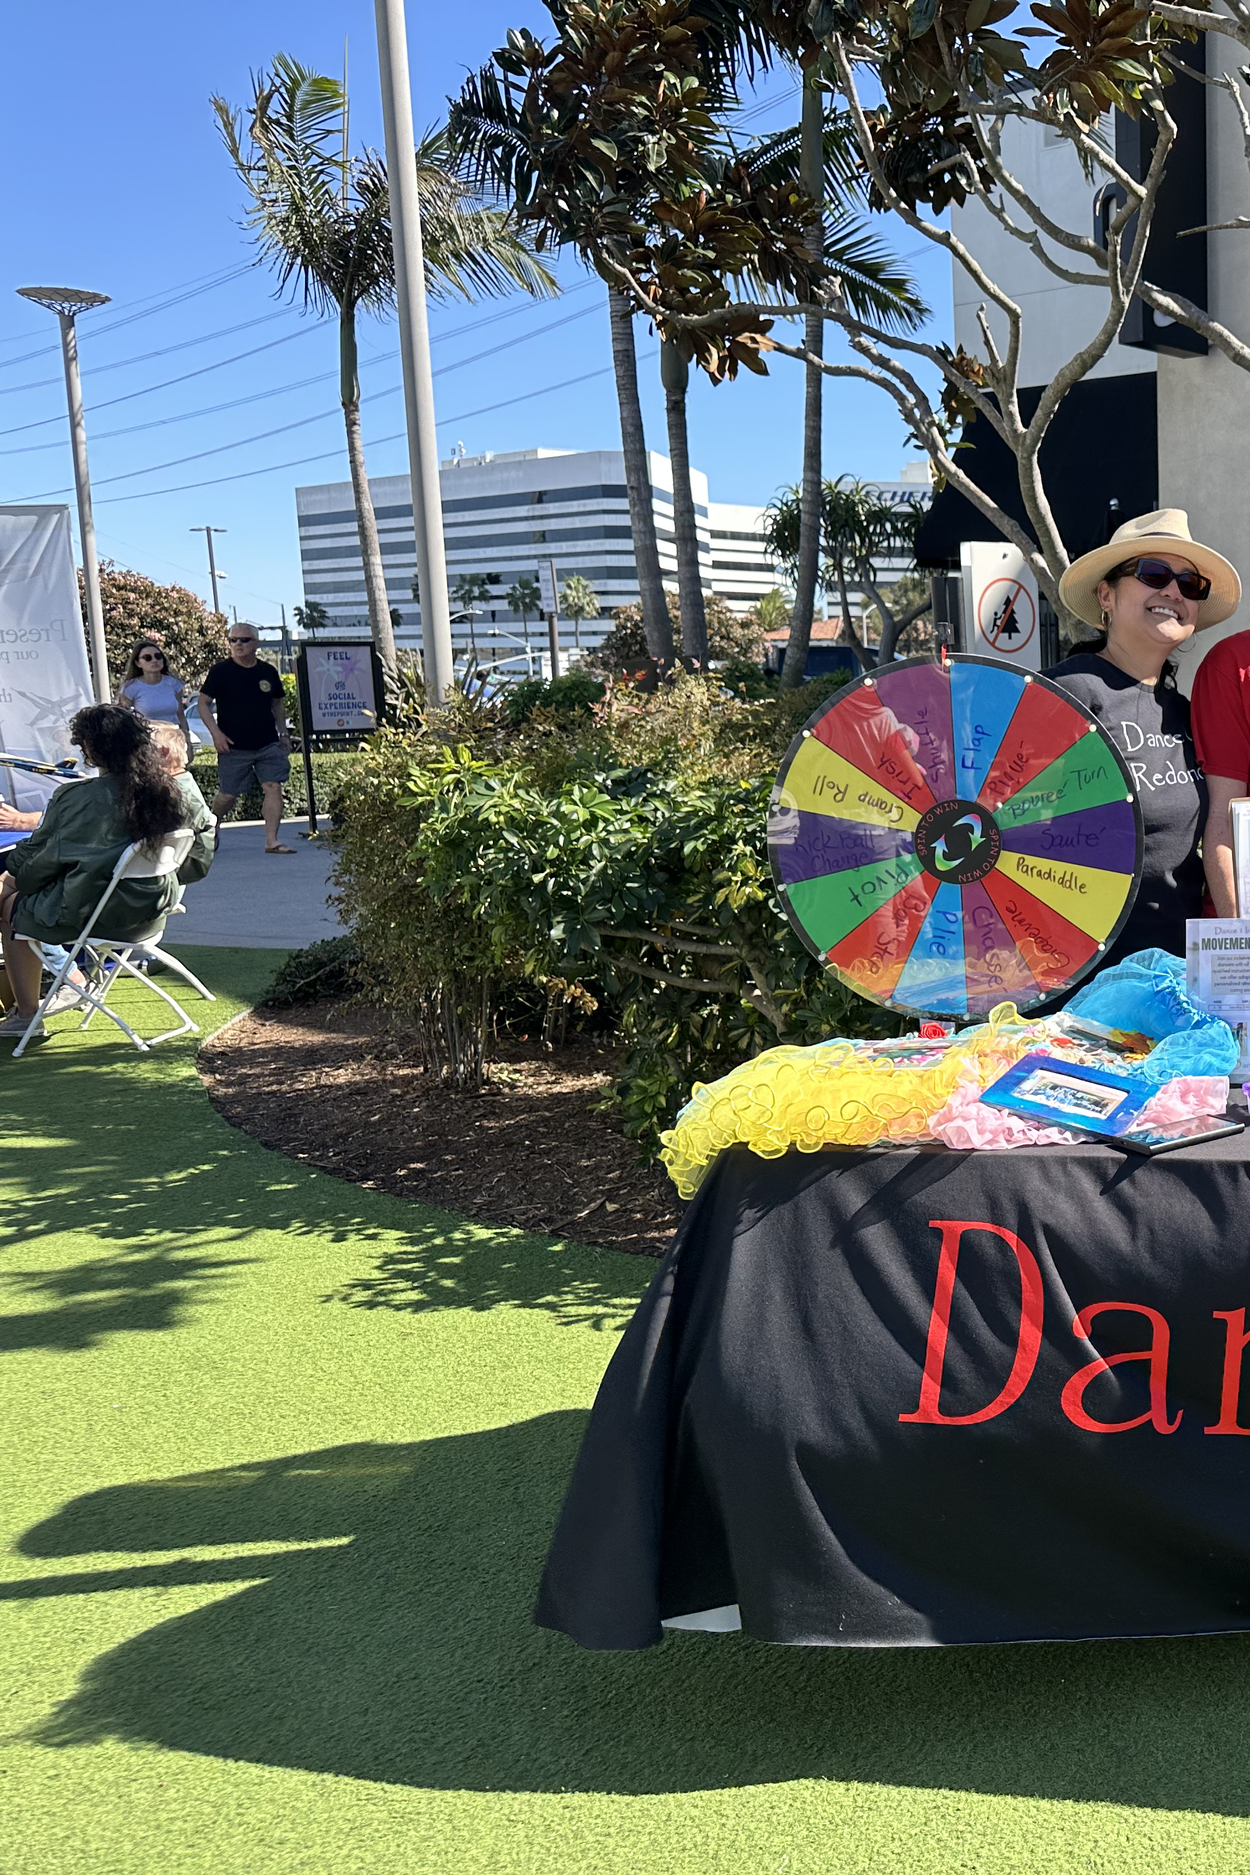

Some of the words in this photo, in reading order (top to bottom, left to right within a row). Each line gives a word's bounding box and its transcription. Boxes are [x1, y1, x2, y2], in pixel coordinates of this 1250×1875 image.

[327, 651, 351, 661] FEEL
[318, 701, 367, 710] EXPERIENCE
[328, 693, 356, 701] SOCIAL
[962, 724, 992, 770] Flap
[1120, 721, 1184, 752] Dance
[812, 775, 849, 803] Roll
[877, 752, 922, 800] Irish
[1070, 765, 1108, 791] Turn
[858, 791, 904, 824] Cramp
[921, 814, 934, 827] TO
[934, 802, 959, 815] WIN
[839, 828, 876, 850] Ball
[917, 830, 928, 856] SPIN
[989, 828, 999, 856] SPIN
[810, 852, 870, 873] Change
[958, 869, 983, 882] WIN
[982, 858, 995, 871] TO
[1016, 856, 1088, 895] Paradiddle
[848, 863, 909, 908] Pivot
[892, 894, 928, 929] Box
[1006, 899, 1070, 969] Grapevine
[1214, 926, 1238, 935] Dance
[870, 931, 900, 975] Step
